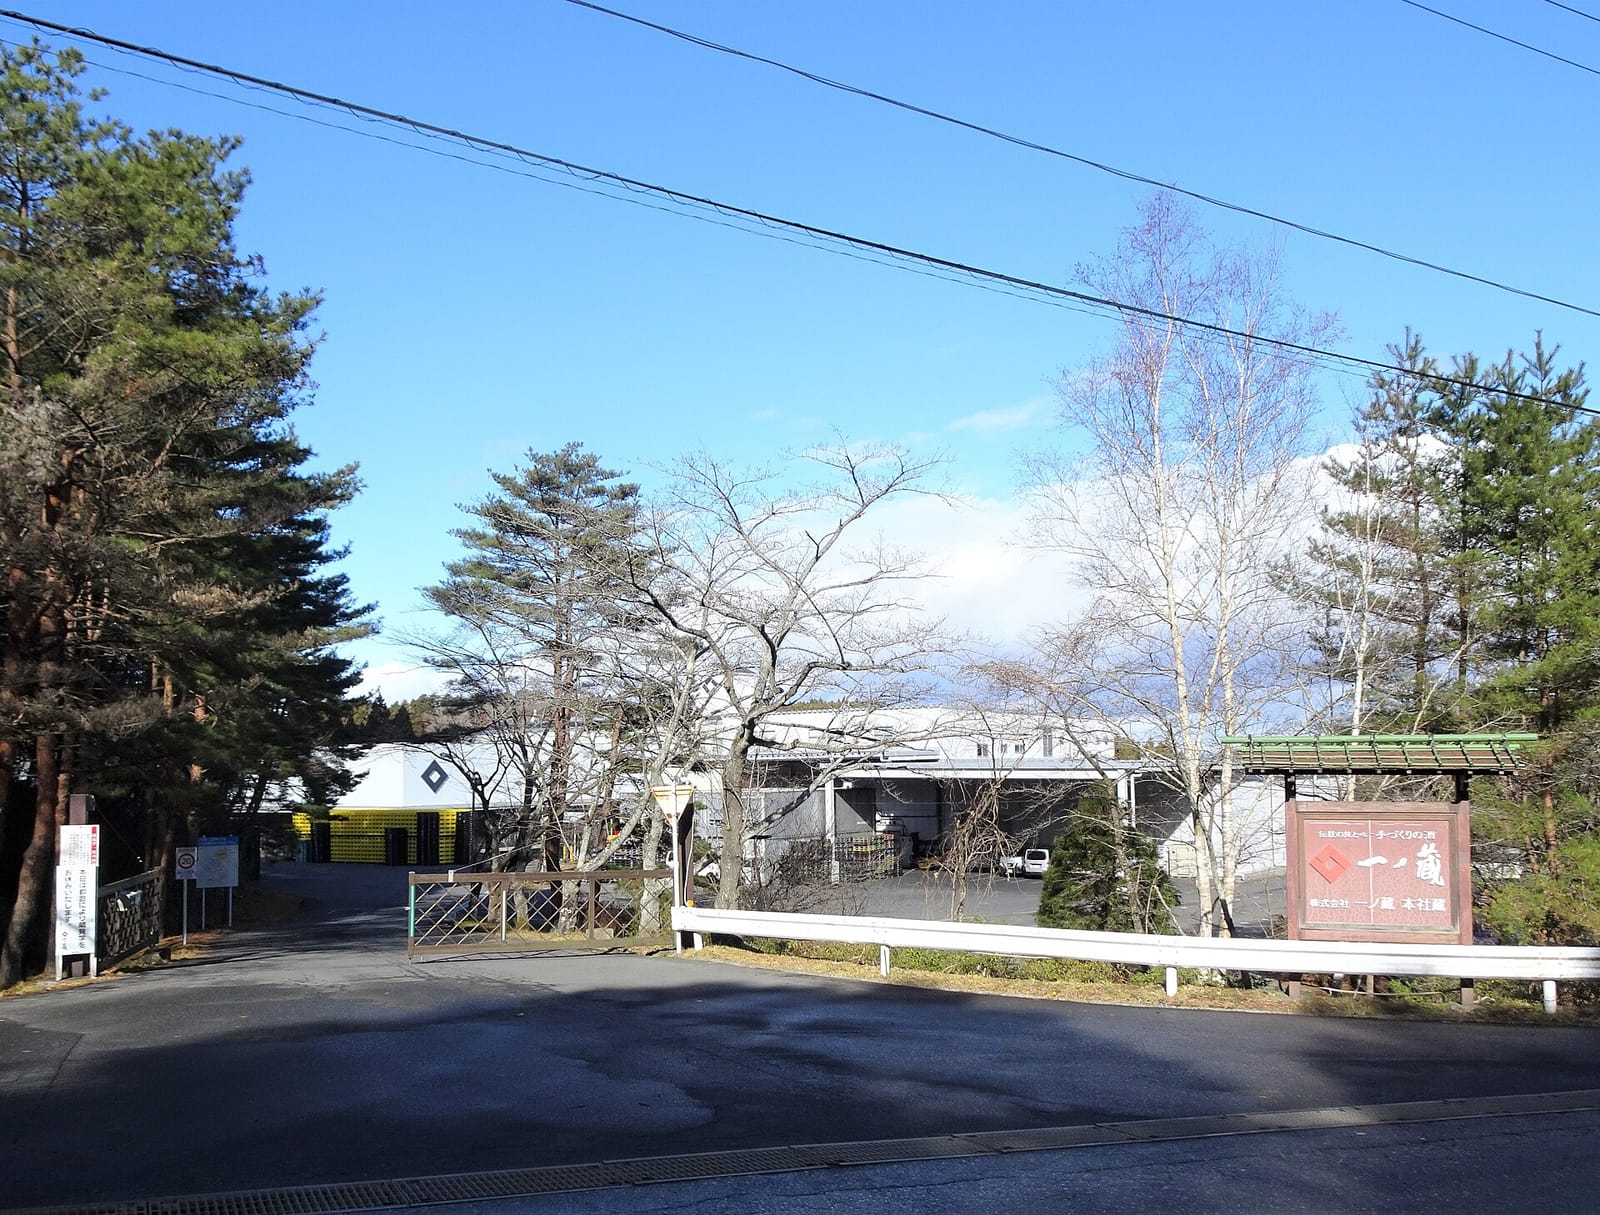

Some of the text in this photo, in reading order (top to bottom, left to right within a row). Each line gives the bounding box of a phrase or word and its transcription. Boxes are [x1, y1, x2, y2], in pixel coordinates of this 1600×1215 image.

[1309, 898, 1350, 909] 株式会社
[1402, 896, 1447, 912] 本社蔵
